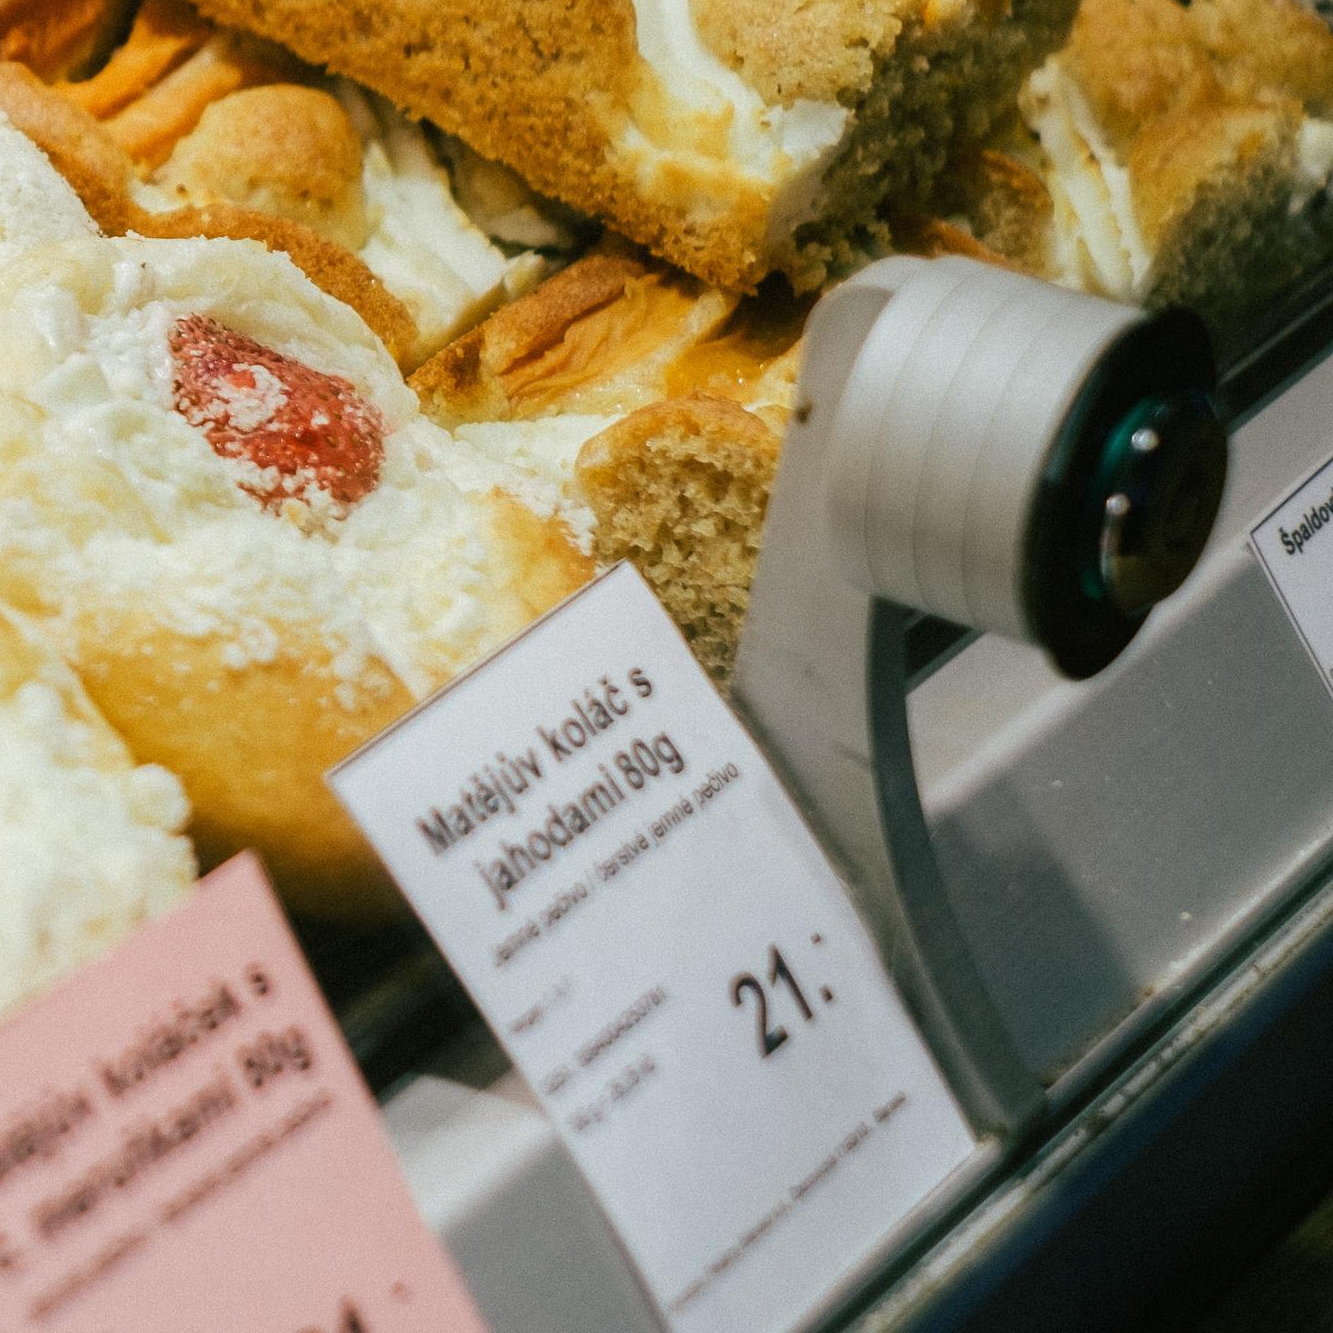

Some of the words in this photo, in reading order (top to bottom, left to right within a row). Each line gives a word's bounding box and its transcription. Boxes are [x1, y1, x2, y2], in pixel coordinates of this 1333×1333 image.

[1279, 487, 1333, 555] Špaldov
[414, 750, 544, 857] Matějův
[537, 676, 629, 762] koláč
[628, 667, 653, 698] s
[473, 765, 625, 912] jahodami
[614, 731, 686, 790] 80g
[692, 762, 740, 810] pečivo
